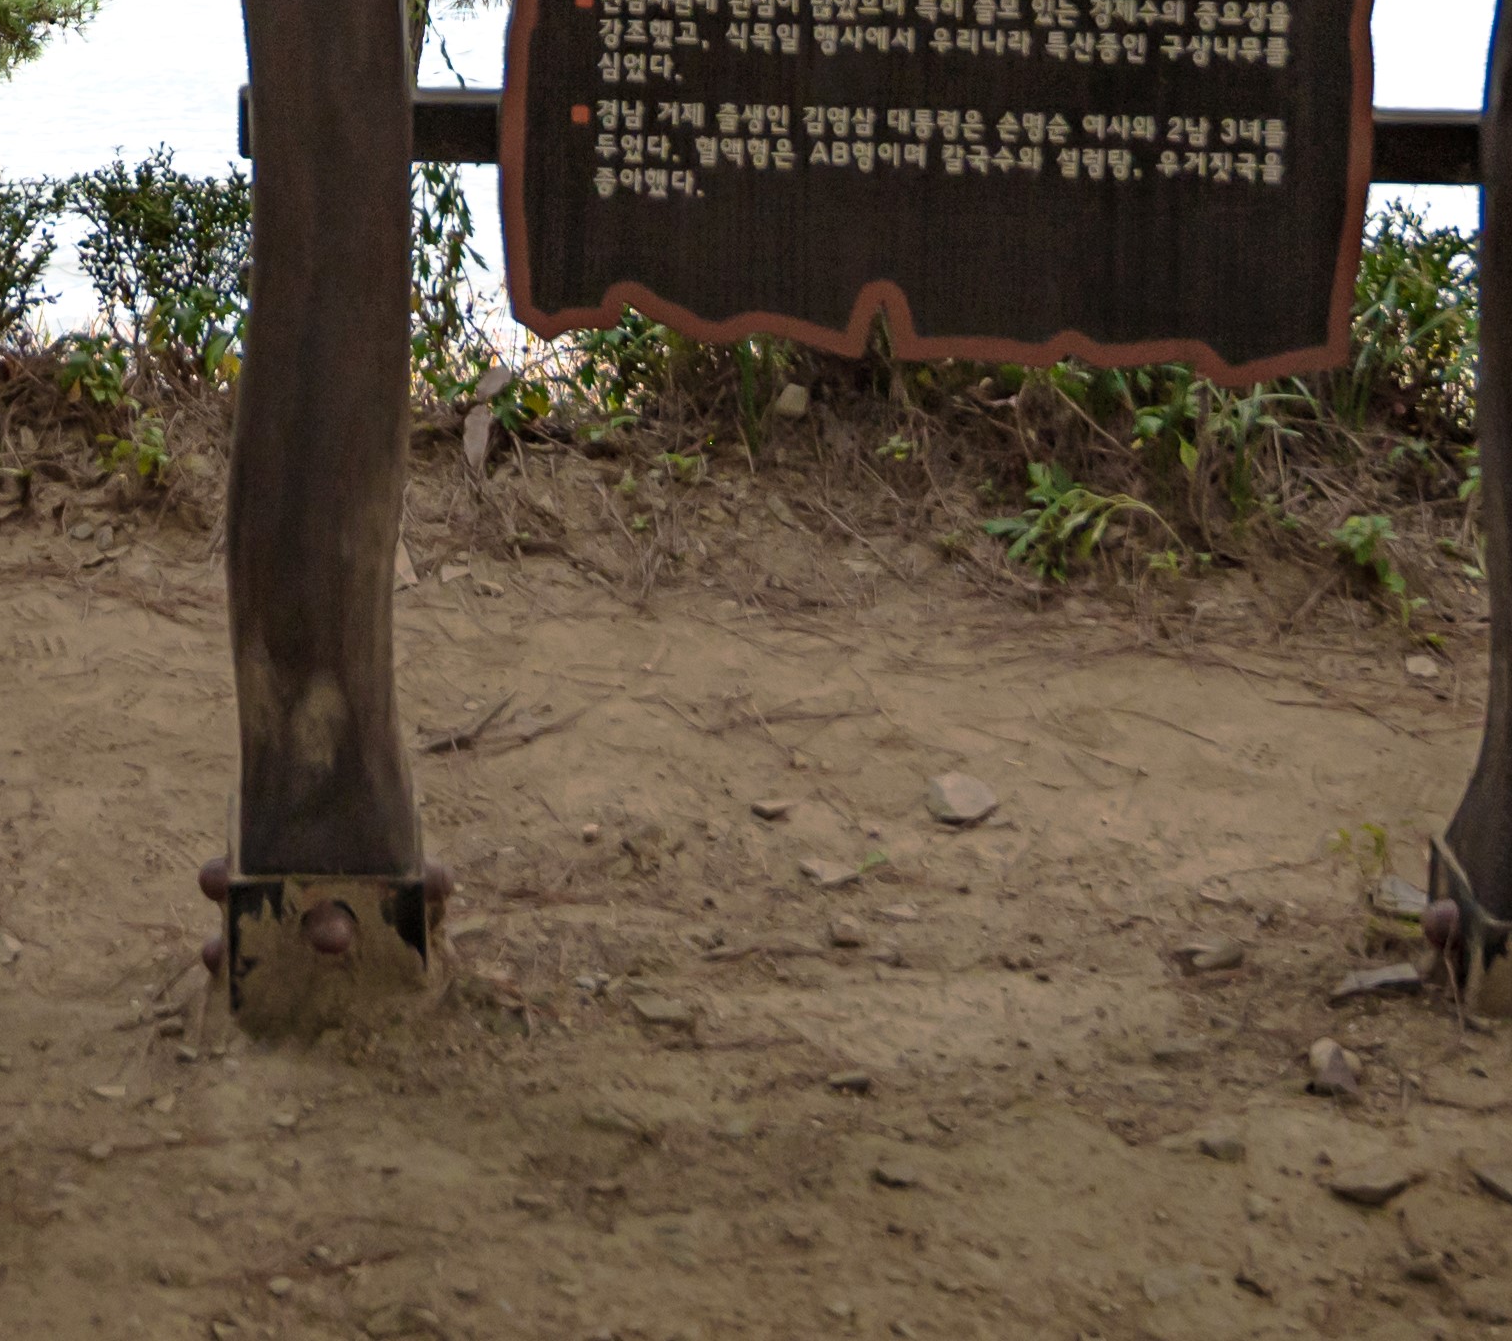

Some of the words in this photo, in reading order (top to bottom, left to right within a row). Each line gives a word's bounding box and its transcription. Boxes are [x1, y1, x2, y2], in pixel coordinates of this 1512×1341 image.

[1194, 0, 1291, 33] 중요성을
[725, 21, 799, 54] 식목일
[814, 23, 915, 56] 행사에서
[929, 26, 1031, 55] 우리나라
[1045, 30, 1146, 64] 특산종인
[1161, 34, 1288, 67] 구상나무를
[597, 51, 682, 83] 심었다.
[596, 98, 644, 130] 경남
[658, 101, 704, 128] 거제
[717, 101, 788, 135] 출생인
[803, 105, 876, 138] 김영삼
[887, 108, 983, 140] 대통령은
[996, 111, 1069, 143] 손명순
[1082, 114, 1155, 140] 여사와
[1167, 117, 1209, 147] 2남
[1221, 117, 1286, 149] 3녀를
[595, 132, 678, 163] 두었다.
[695, 135, 795, 169] 혈액형은
[809, 140, 927, 172] AB형이며
[942, 143, 1042, 174] 칼국수와
[593, 166, 705, 199] 좋아했다.
